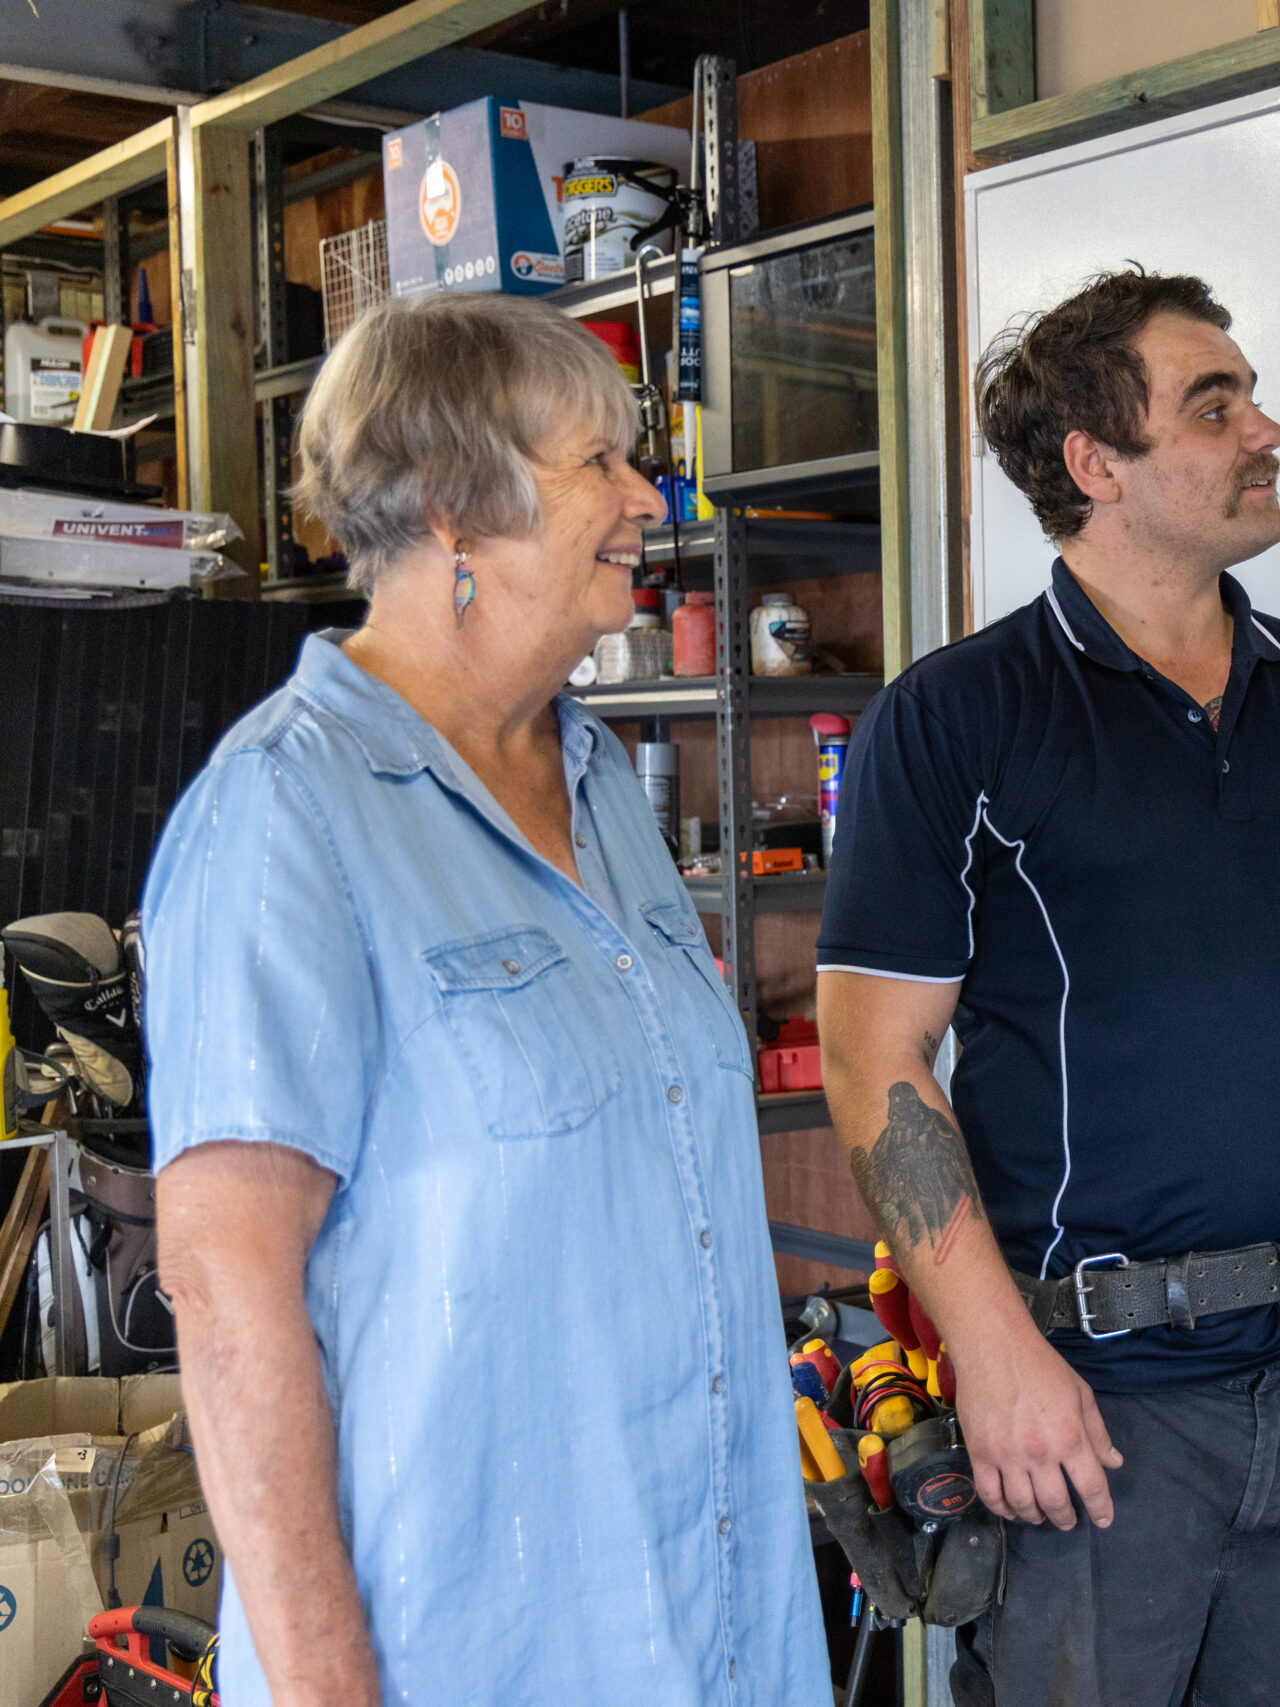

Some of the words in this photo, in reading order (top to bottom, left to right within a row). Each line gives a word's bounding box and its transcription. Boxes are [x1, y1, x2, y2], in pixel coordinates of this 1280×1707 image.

[504, 113, 522, 128] 10
[566, 177, 613, 198] IGGERS
[62, 522, 145, 536] UNIVENT
